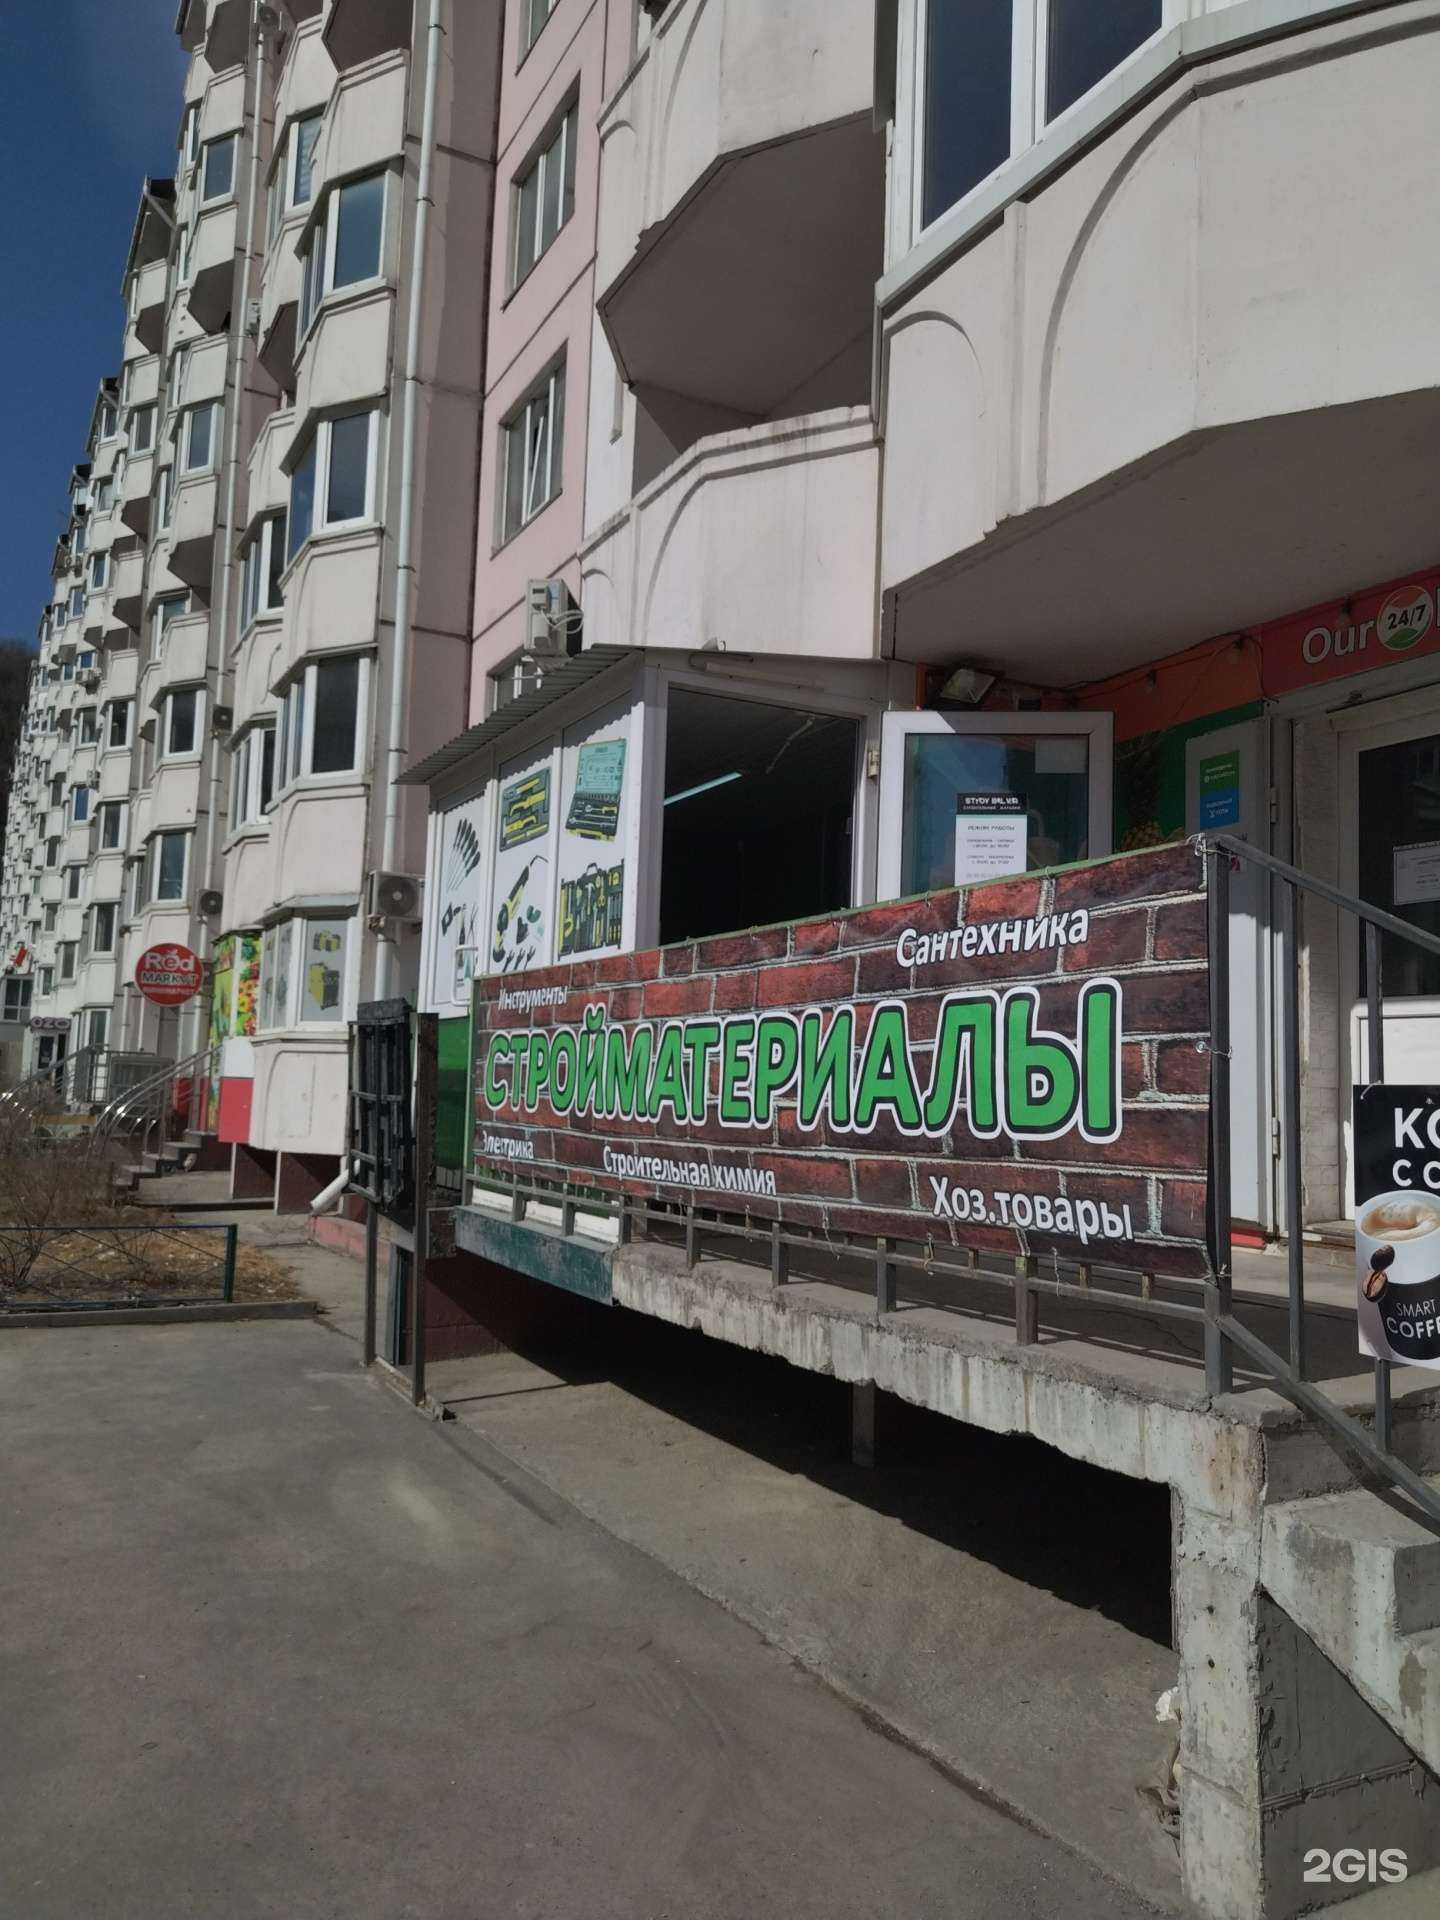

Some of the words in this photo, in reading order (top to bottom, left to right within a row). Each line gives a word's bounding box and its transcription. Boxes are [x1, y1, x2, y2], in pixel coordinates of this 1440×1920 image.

[1387, 604, 1426, 630] 24/7
[1303, 620, 1375, 664] Our
[896, 908, 1090, 968] Сантехника
[498, 985, 568, 1014] Инструменты
[483, 977, 1123, 1145] СТРОЙМАТЕРИАЛЫ
[482, 1130, 535, 1161] Электрика
[603, 1145, 711, 1187] Строительная
[711, 1165, 777, 1196] химия
[929, 1176, 1133, 1245] Хоз.товары
[1395, 1299, 1436, 1318] SMART
